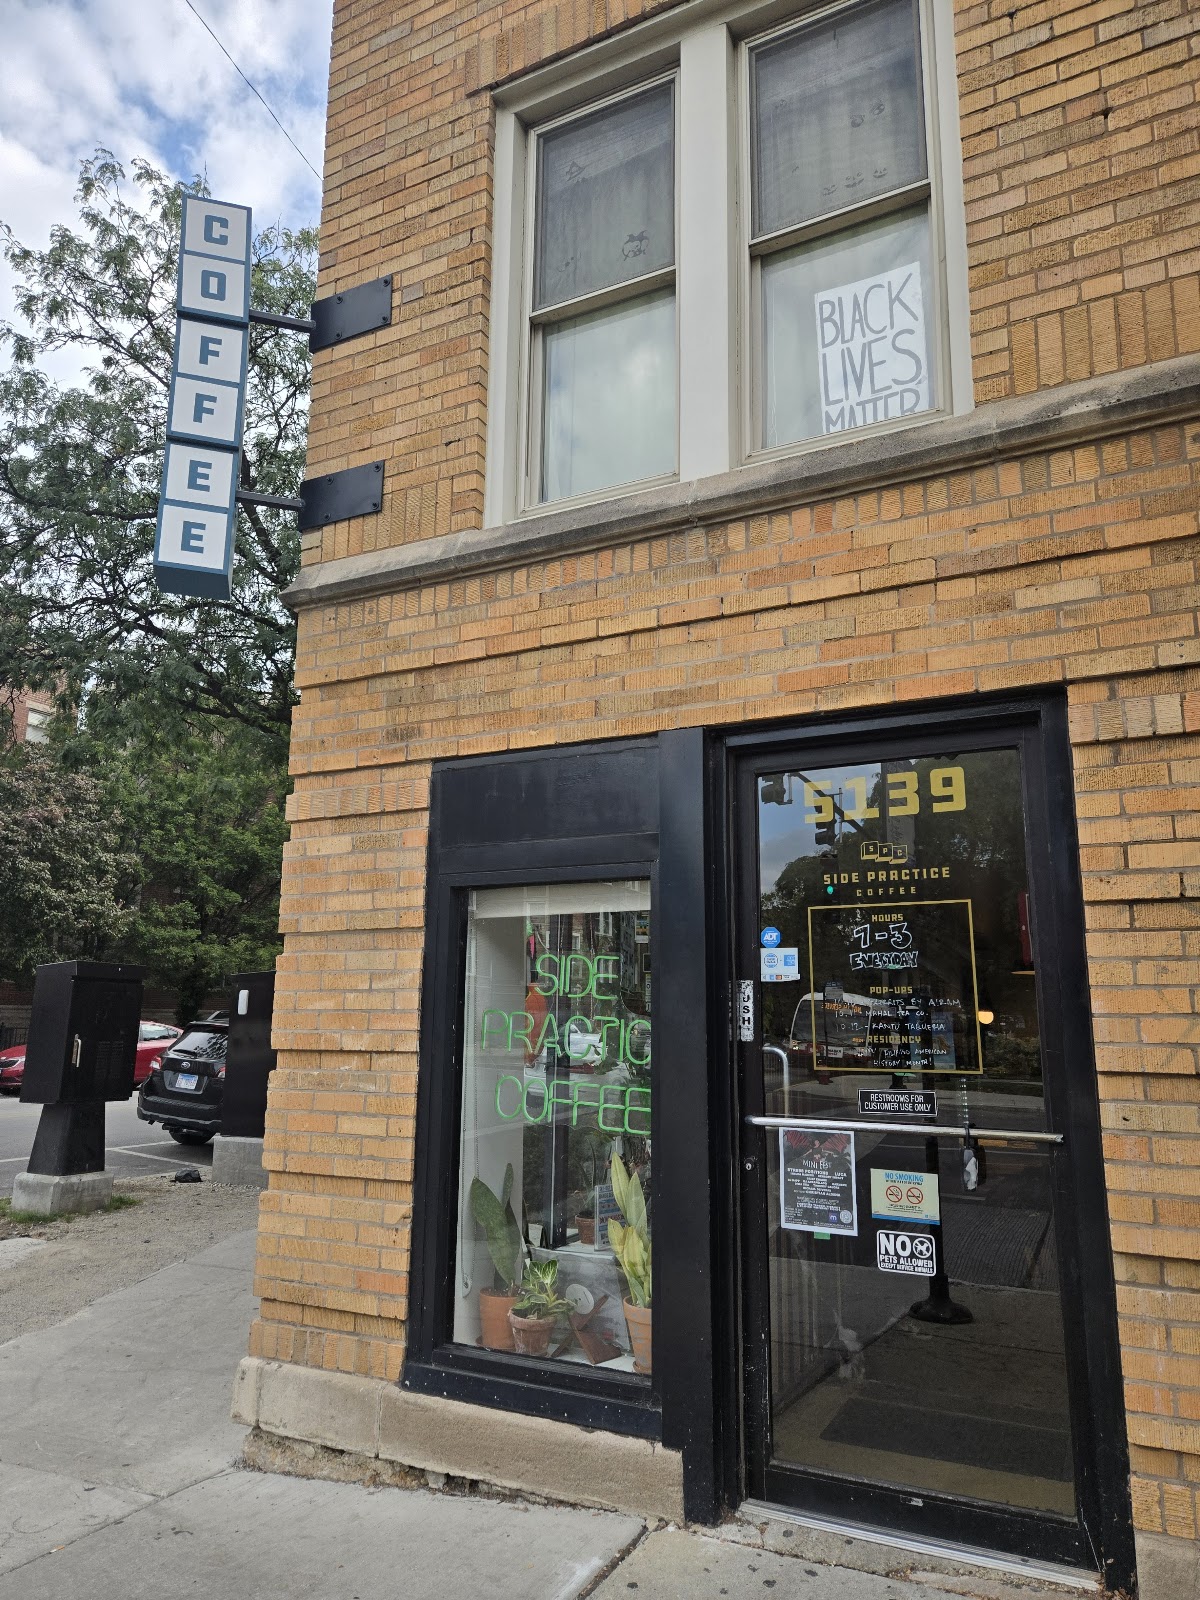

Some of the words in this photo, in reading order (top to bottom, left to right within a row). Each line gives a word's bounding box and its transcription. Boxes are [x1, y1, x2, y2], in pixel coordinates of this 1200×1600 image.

[818, 272, 919, 349] BLACK
[821, 328, 923, 406] LIVES
[180, 214, 229, 554] COFFEE
[804, 766, 967, 825] 5139
[823, 872, 860, 885] SIDE
[867, 866, 950, 883] PRACTICE
[856, 886, 917, 897] COFFEE
[871, 913, 904, 922] HOURS
[763, 932, 778, 941] ADT
[534, 954, 619, 1000] SIDE
[870, 986, 913, 995] POP-UPS
[867, 1035, 922, 1044] RESIDENCY
[495, 1075, 651, 1135] COFFEE
[870, 1093, 910, 1102] RESTROOMS
[911, 1095, 924, 1103] FOR
[864, 1102, 899, 1111] CUSTOMER
[900, 1103, 914, 1111] USE
[914, 1104, 931, 1112] ONLY
[885, 1172, 894, 1180] NO
[895, 1173, 924, 1182] SMOKING
[880, 1233, 911, 1257] NO
[880, 1254, 898, 1264] PETS
[900, 1256, 933, 1268] ALLOWED
